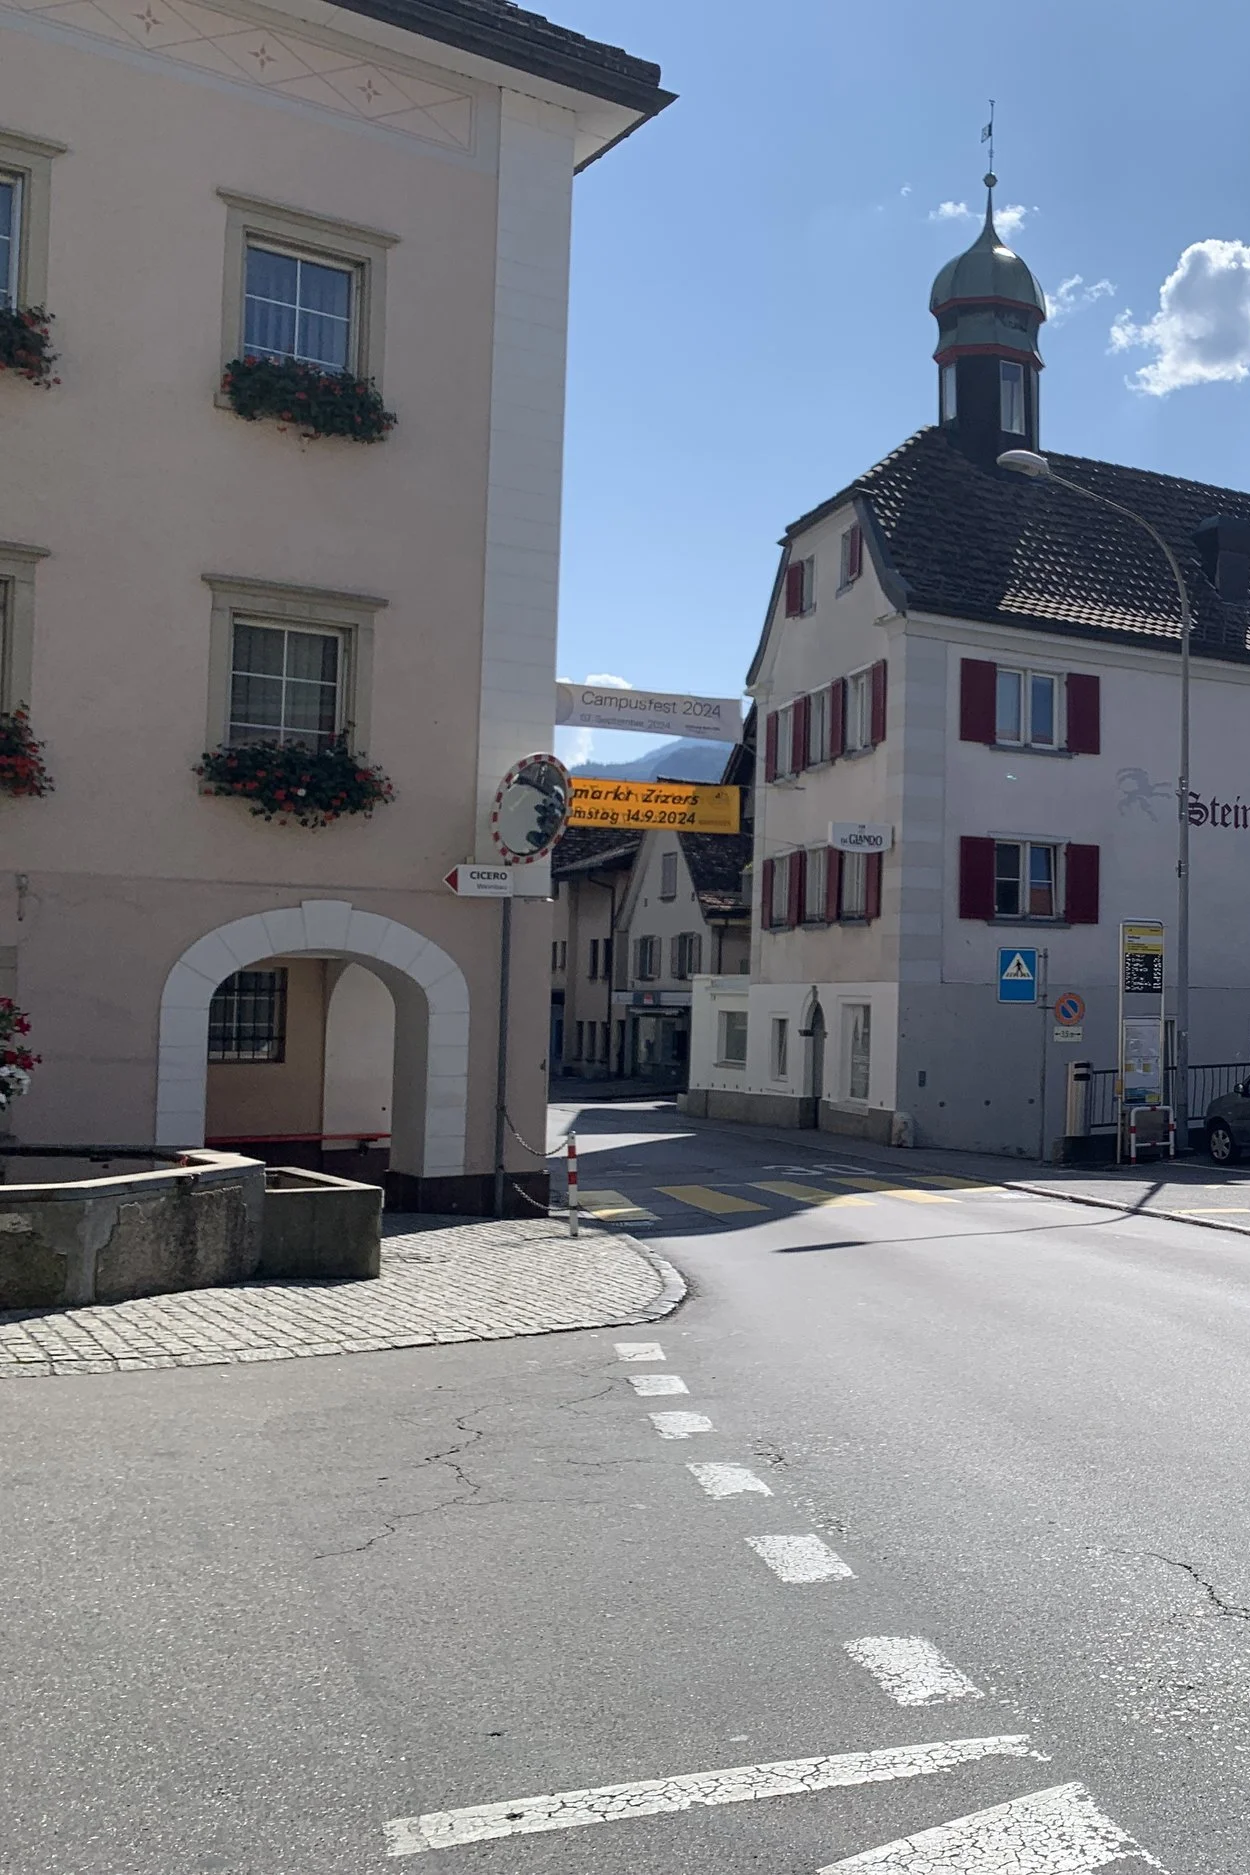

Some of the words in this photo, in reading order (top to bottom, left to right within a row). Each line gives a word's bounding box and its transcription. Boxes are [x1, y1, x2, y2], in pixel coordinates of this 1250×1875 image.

[581, 691, 677, 714] Campusfest
[682, 700, 721, 719] 2024
[573, 786, 632, 801] markt
[641, 789, 699, 805] Zizers
[573, 808, 619, 824] mstag
[626, 809, 696, 825] 14.9.2024
[469, 871, 508, 881] CICERO
